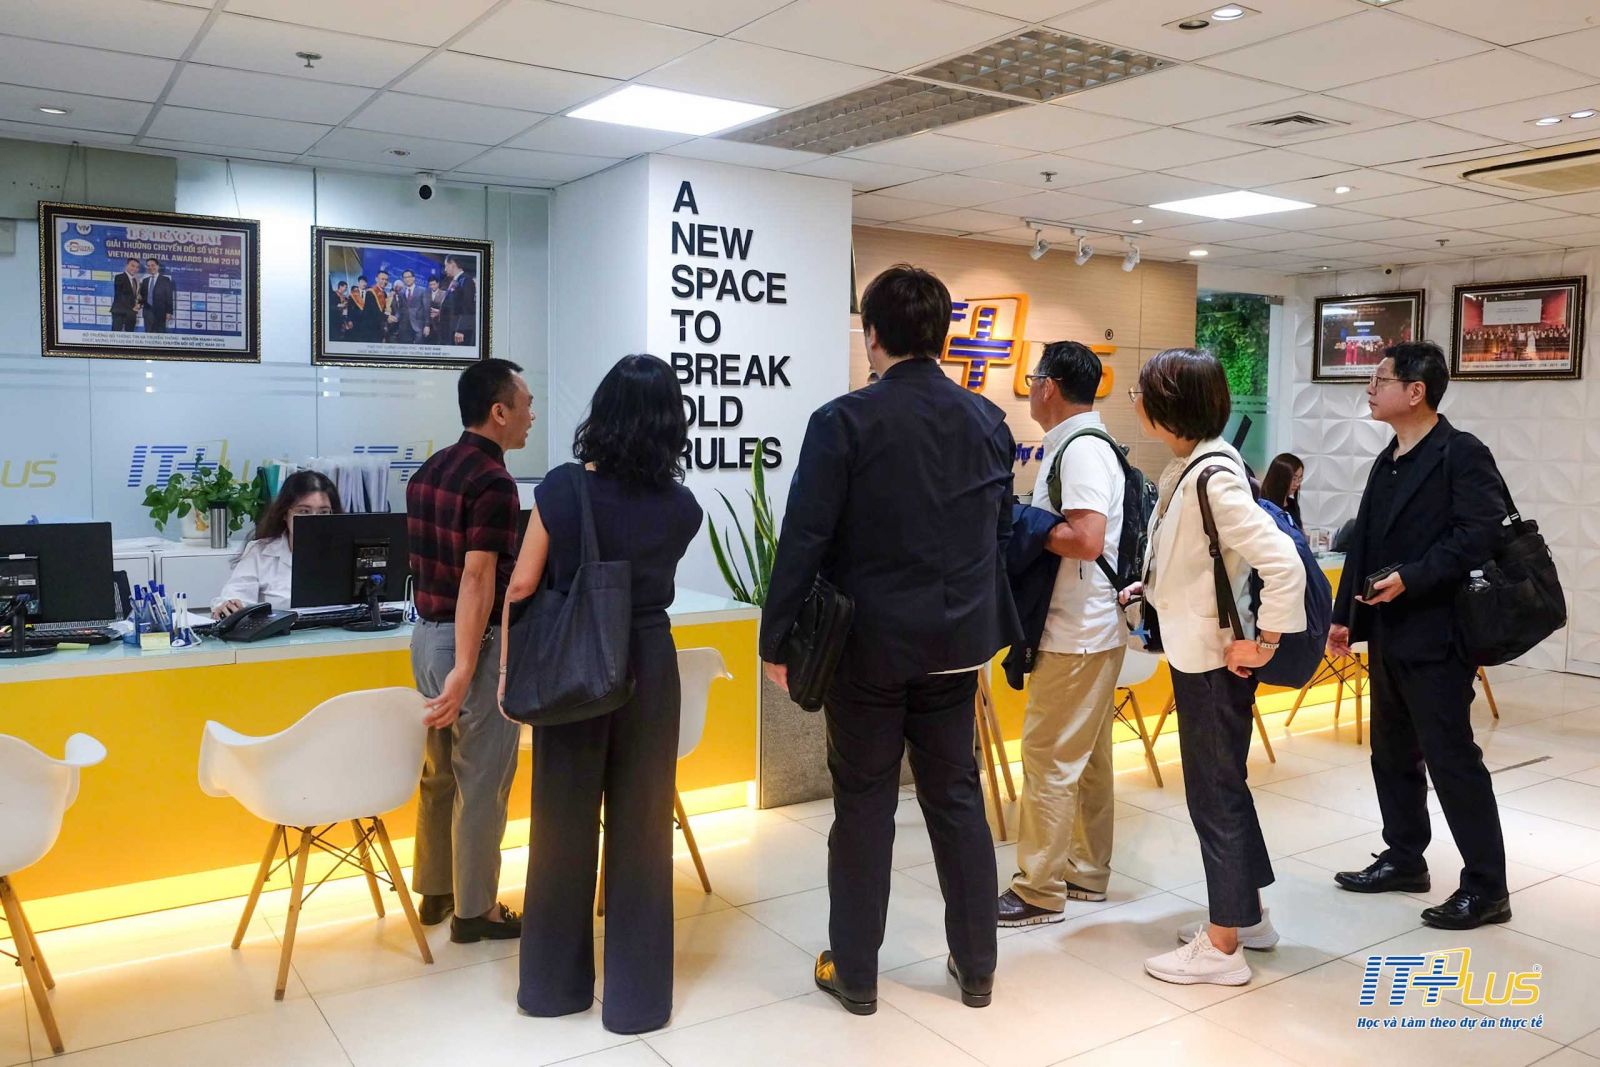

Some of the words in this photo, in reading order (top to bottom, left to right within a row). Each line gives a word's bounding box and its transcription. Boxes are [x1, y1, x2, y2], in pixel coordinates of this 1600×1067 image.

[672, 180, 699, 215] A
[108, 250, 140, 259] VIETNAM
[142, 252, 169, 261] DIGITAL
[171, 254, 202, 263] AWARDS
[224, 248, 241, 256] NAM
[671, 221, 754, 260] NEW
[671, 264, 787, 304] SPACE
[671, 308, 722, 344] TO
[671, 352, 791, 386] BREAK
